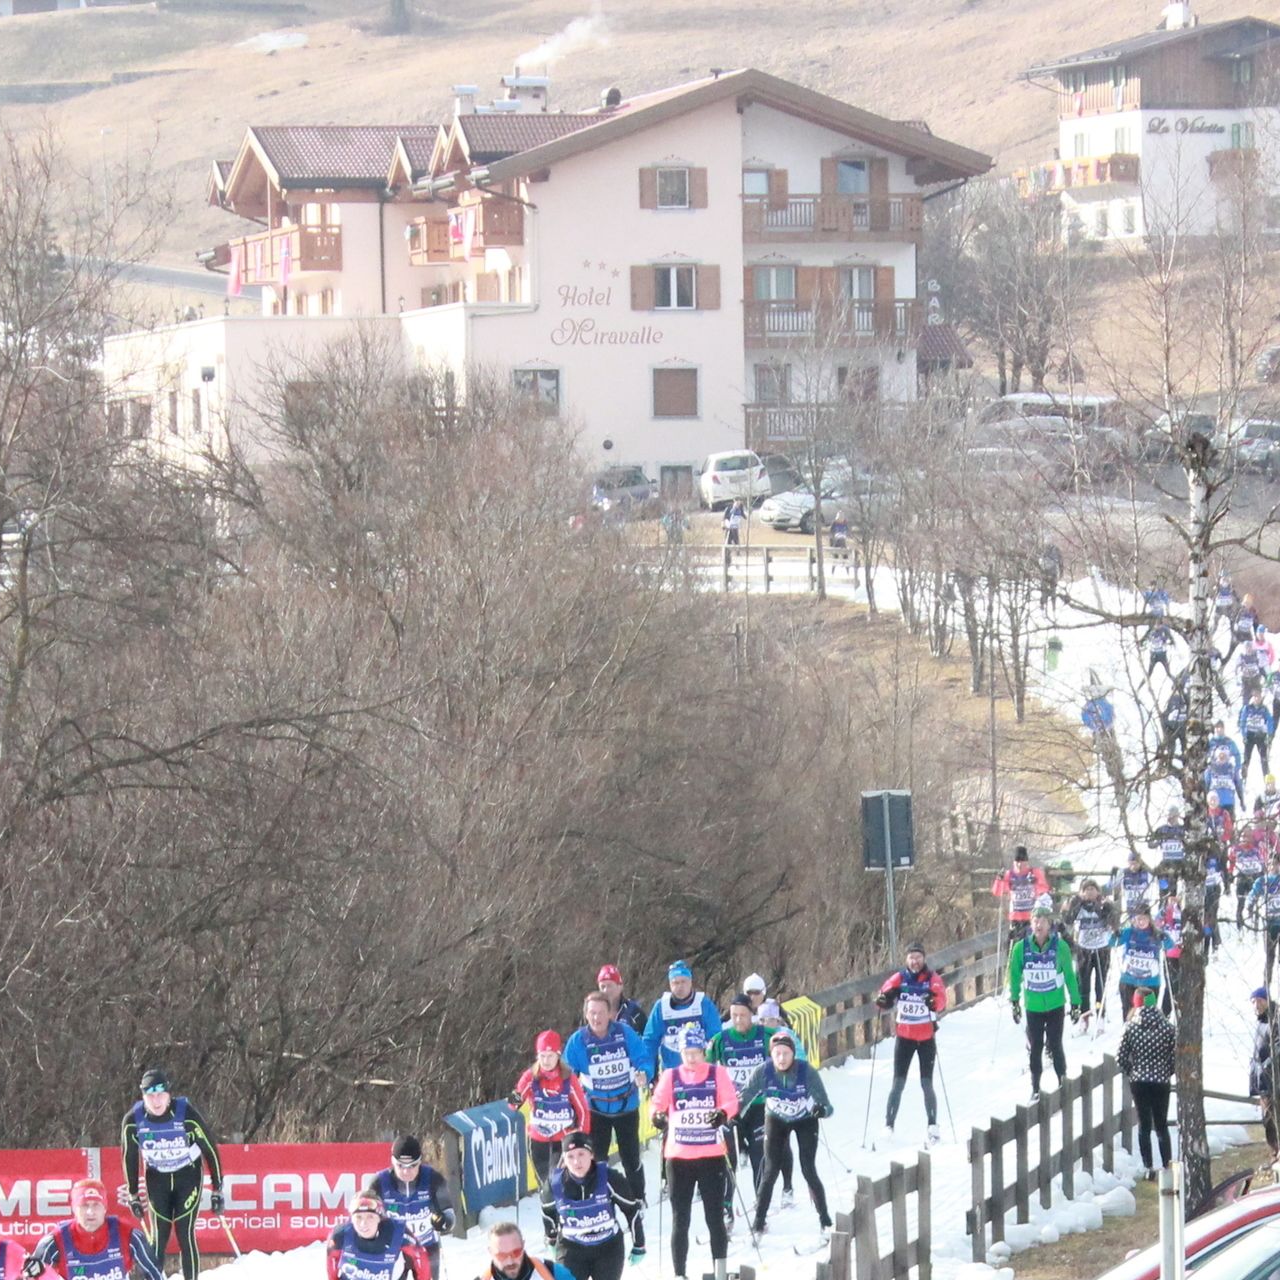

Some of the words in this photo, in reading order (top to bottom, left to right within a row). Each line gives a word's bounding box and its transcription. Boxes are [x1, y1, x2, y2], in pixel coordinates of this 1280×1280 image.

[558, 284, 612, 307] Hotel
[927, 279, 944, 326] BAR
[550, 318, 664, 346] Miravalle
[1029, 971, 1051, 980] 7411
[902, 1003, 925, 1014] 6875
[591, 1047, 626, 1063] Melinda
[728, 1053, 764, 1066] Melinda
[597, 1064, 624, 1076] 6580
[676, 1096, 715, 1110] Melinda
[535, 1110, 570, 1119] Melinda
[142, 1137, 186, 1150] Melinda
[567, 1212, 610, 1227] Melinda
